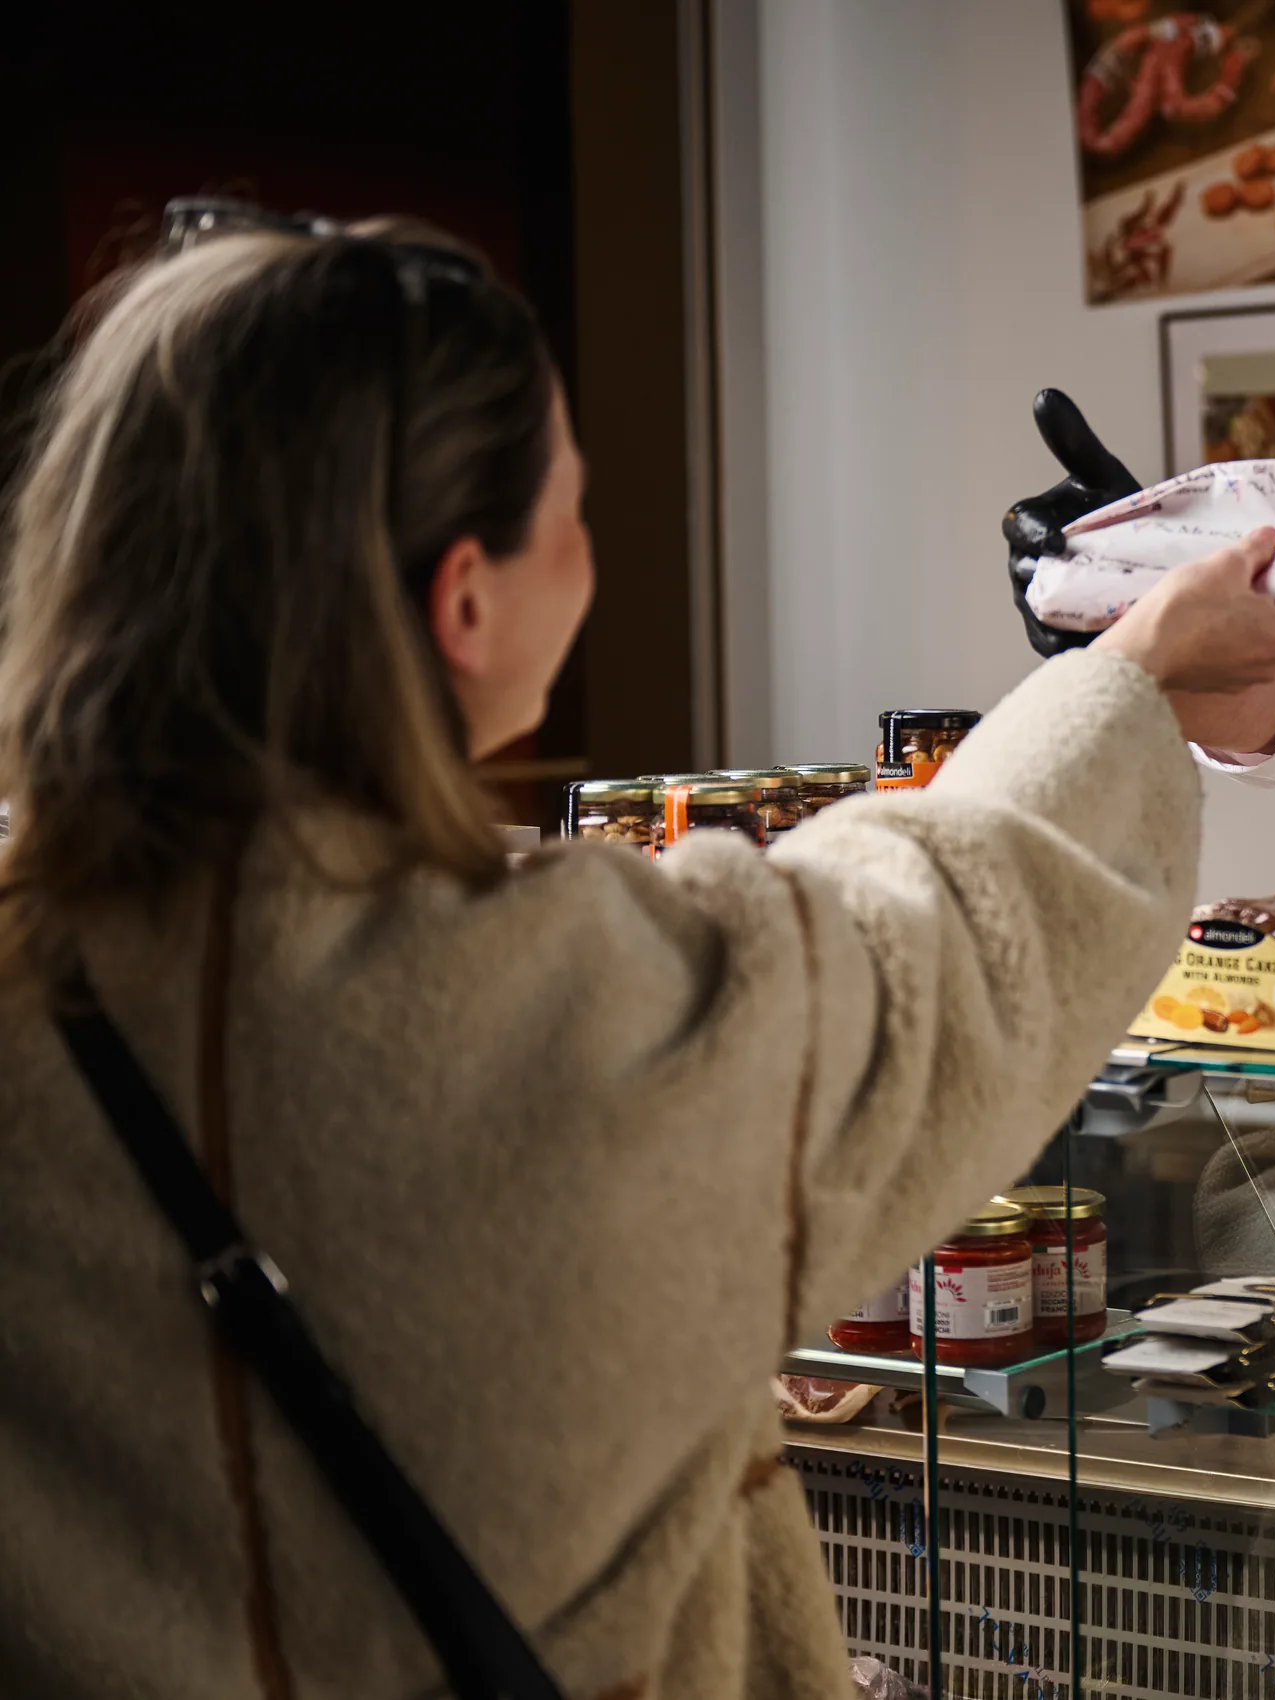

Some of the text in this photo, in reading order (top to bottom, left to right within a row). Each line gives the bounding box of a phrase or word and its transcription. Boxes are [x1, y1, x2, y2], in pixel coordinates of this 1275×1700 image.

[880, 766, 911, 777] almondeli
[1187, 952, 1240, 970] ORANGE
[1183, 970, 1260, 986] WITH ALMONDS
